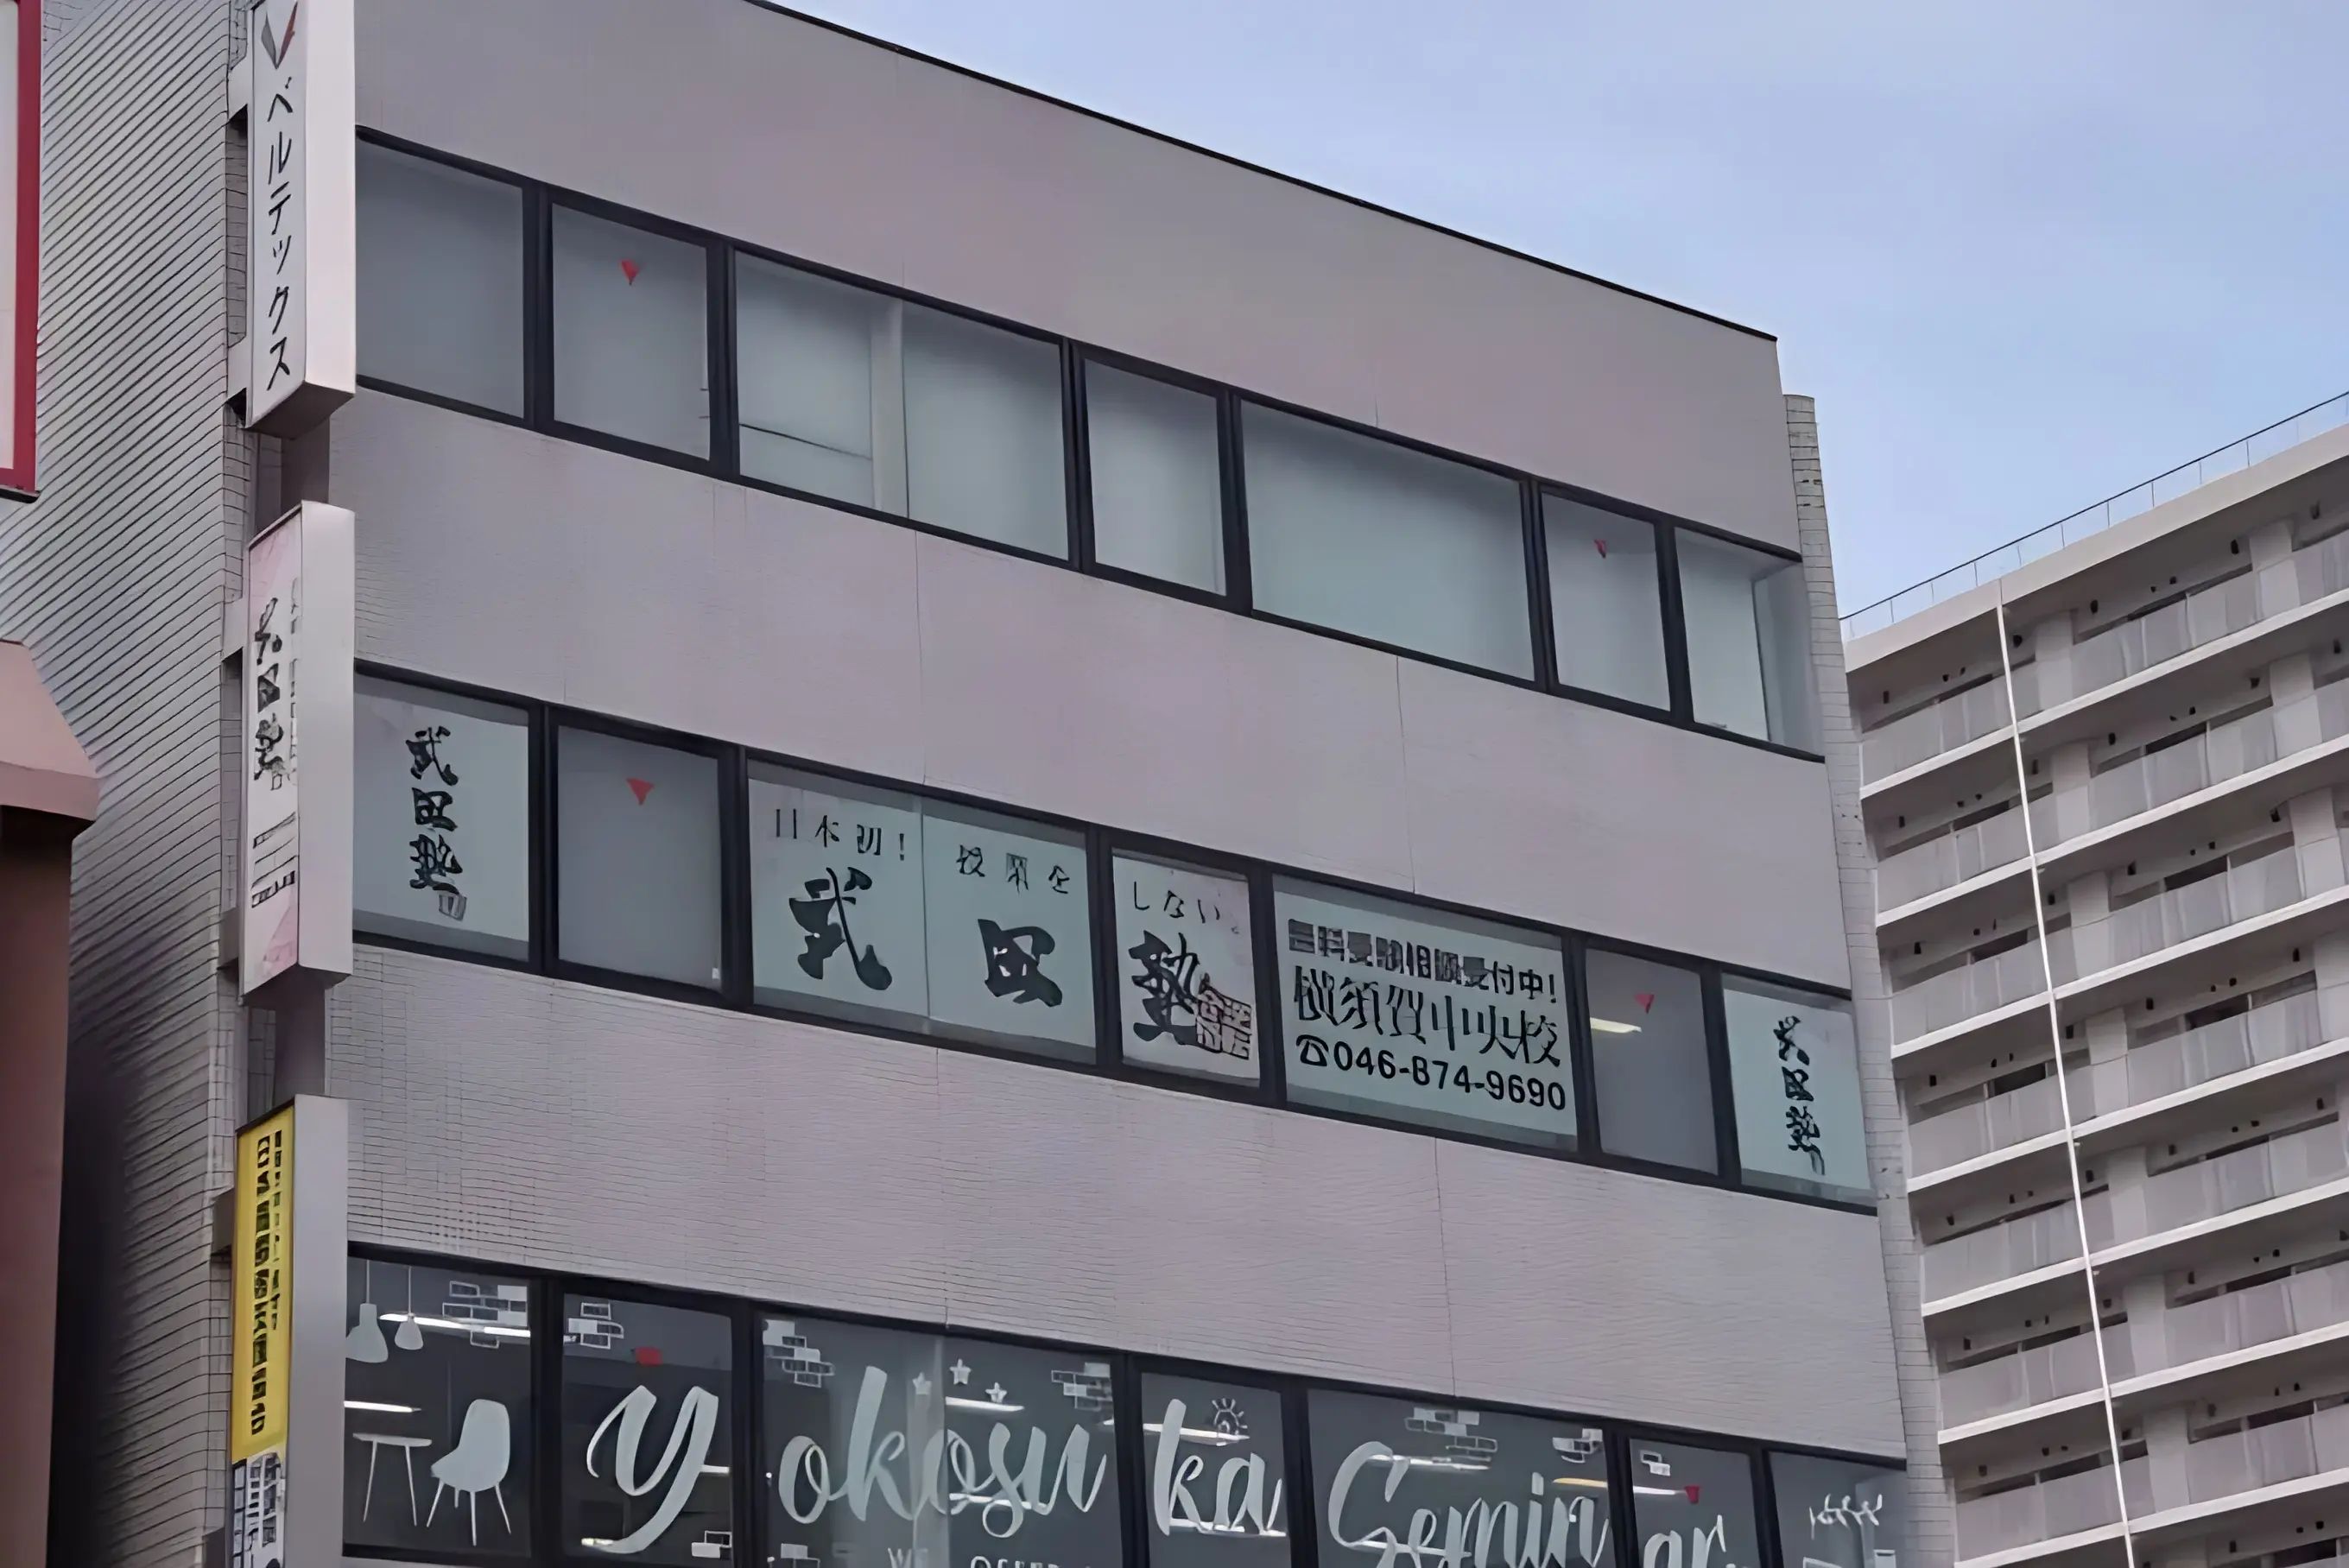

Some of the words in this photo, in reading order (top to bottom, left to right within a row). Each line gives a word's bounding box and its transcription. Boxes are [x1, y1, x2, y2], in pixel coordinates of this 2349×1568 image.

[267, 76, 294, 391] ベルテックス
[405, 725, 464, 895] 武田塾
[1333, 1040, 1567, 1111] 046-874-9690
